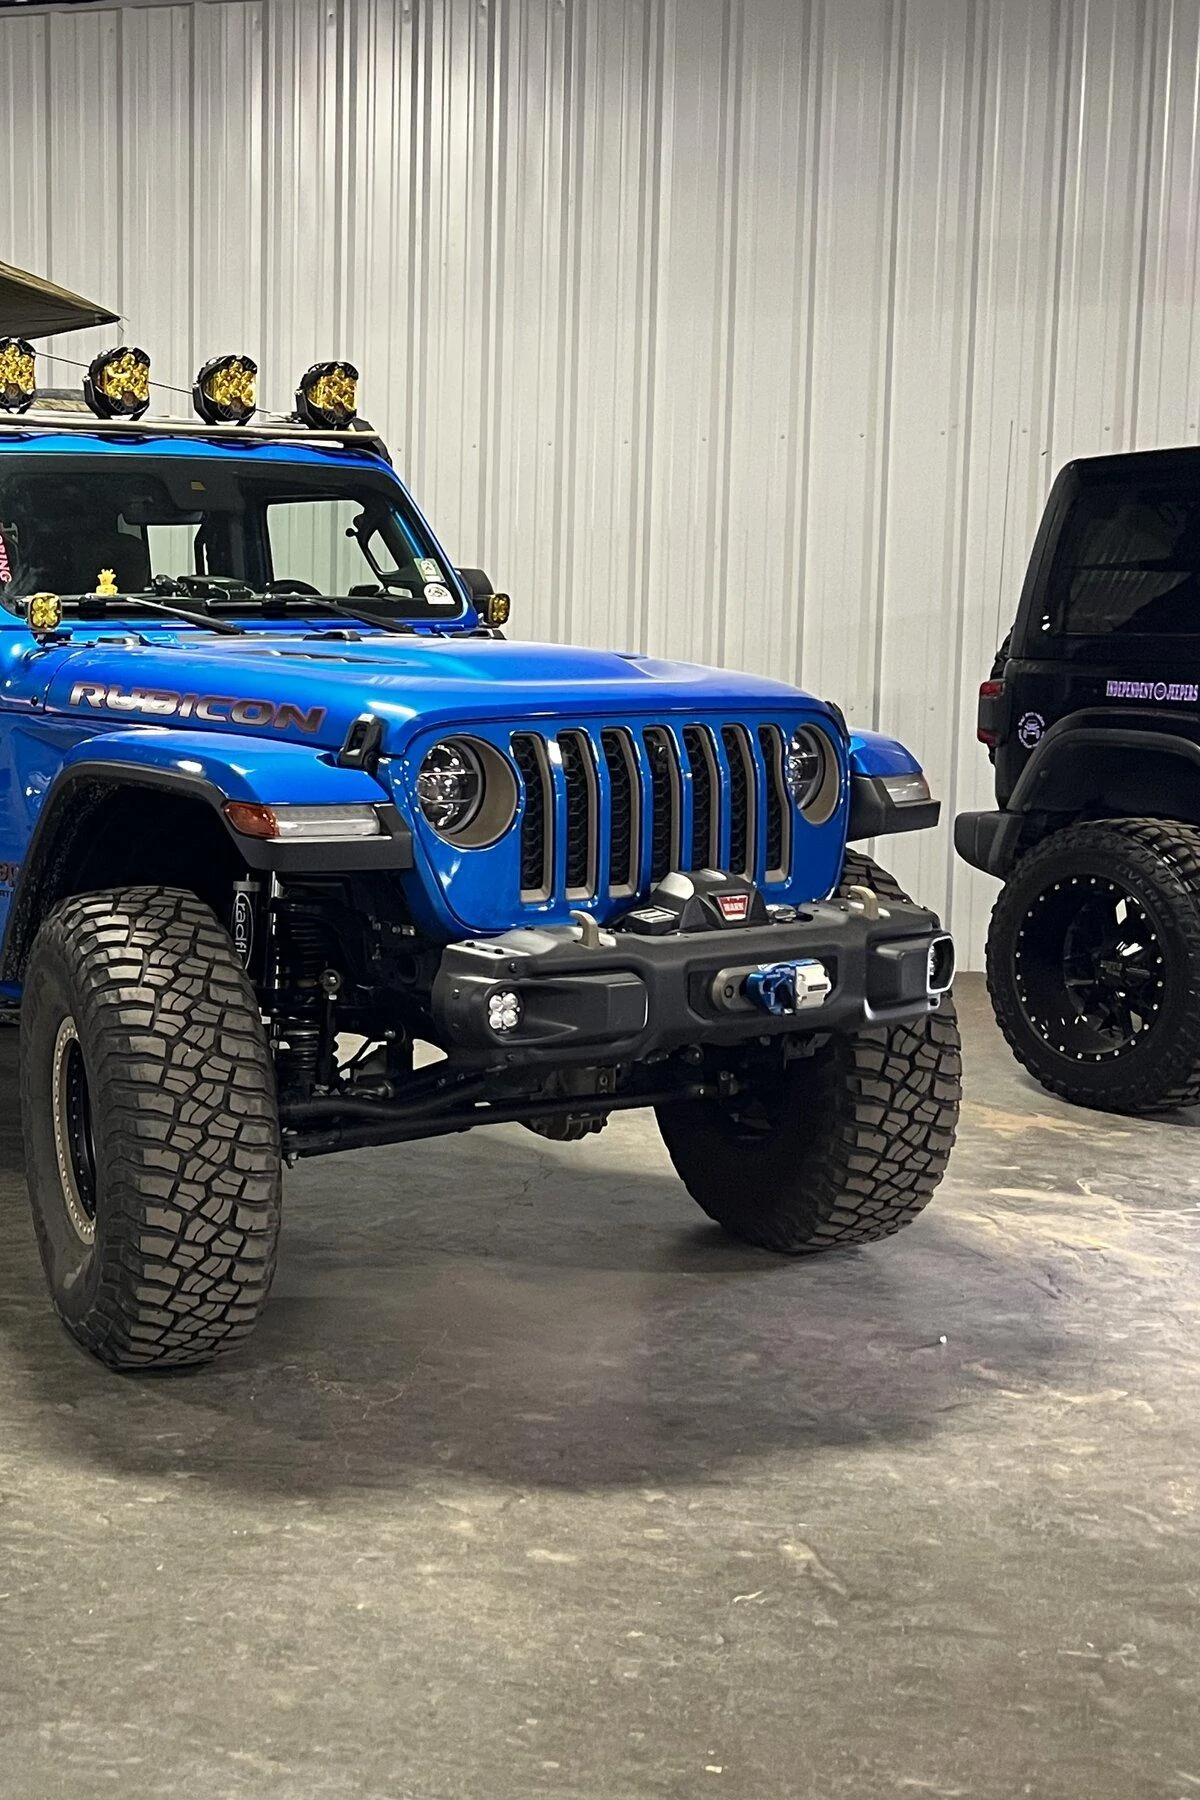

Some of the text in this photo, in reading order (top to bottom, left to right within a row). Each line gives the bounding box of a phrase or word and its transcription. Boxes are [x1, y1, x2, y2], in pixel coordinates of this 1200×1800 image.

[69, 681, 326, 733] RUBICON
[1106, 680, 1199, 701] INDEPENDENT JEEPERS
[234, 902, 247, 954] radfl
